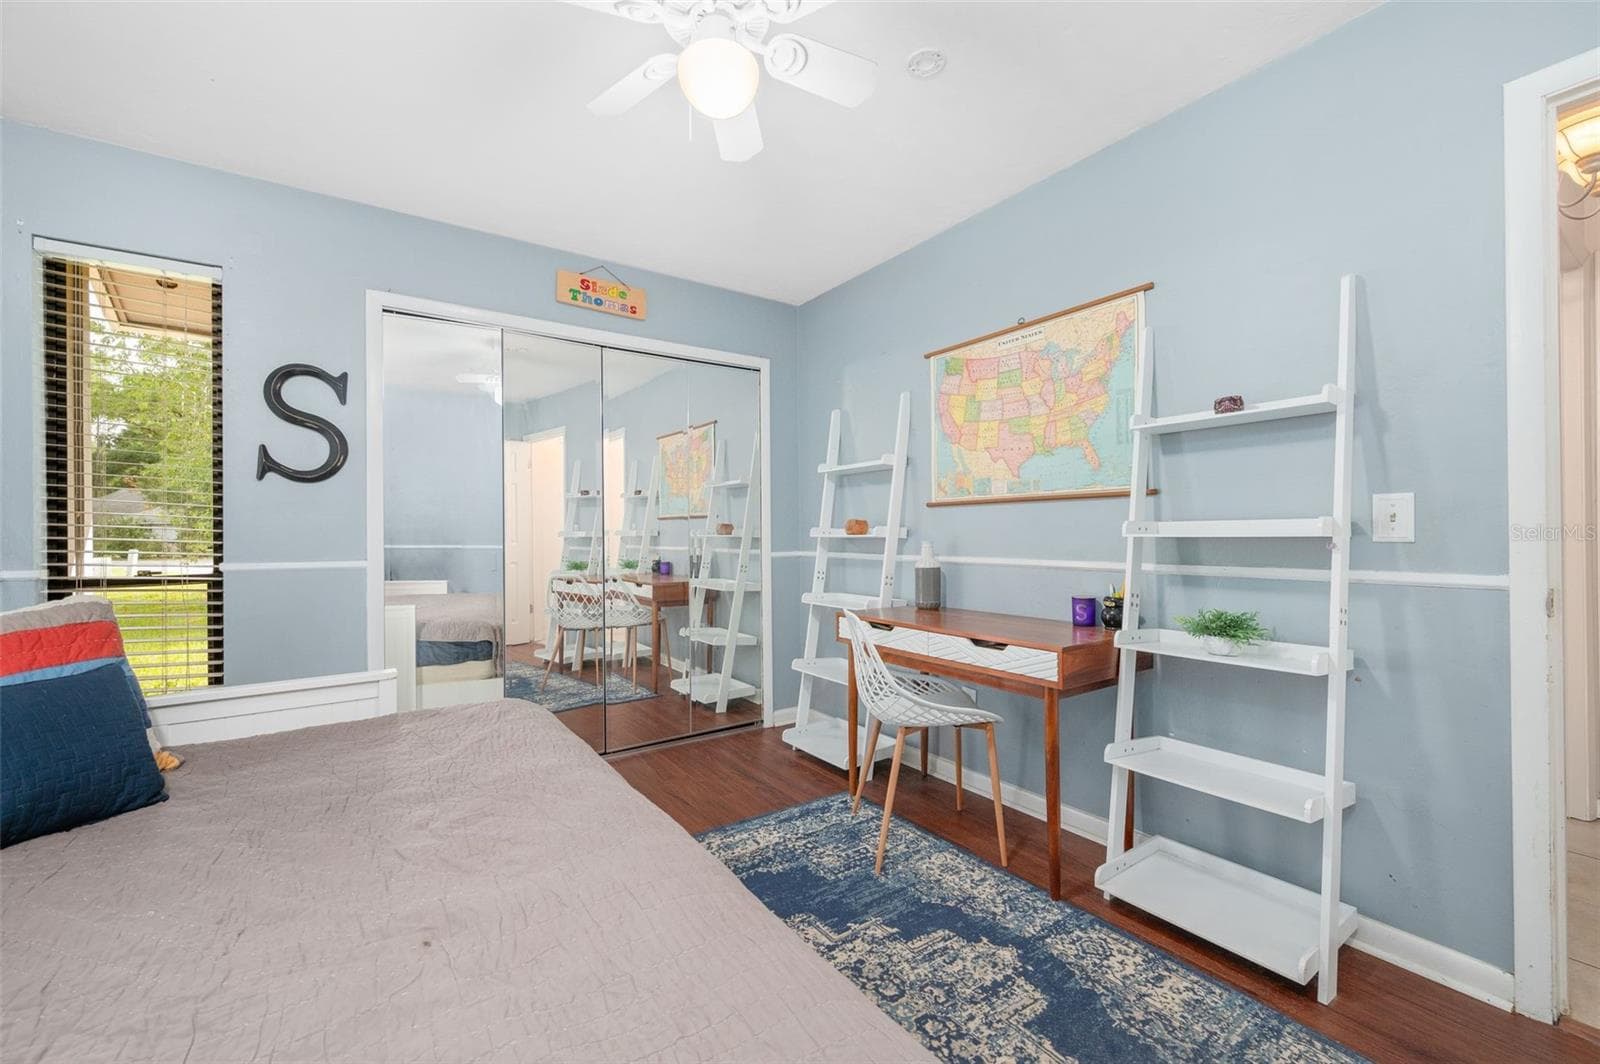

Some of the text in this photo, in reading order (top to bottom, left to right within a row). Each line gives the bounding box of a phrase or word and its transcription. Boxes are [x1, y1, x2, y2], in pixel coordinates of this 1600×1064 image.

[568, 288, 638, 314] Thomas
[256, 363, 349, 483] S
[1075, 603, 1088, 621] S
